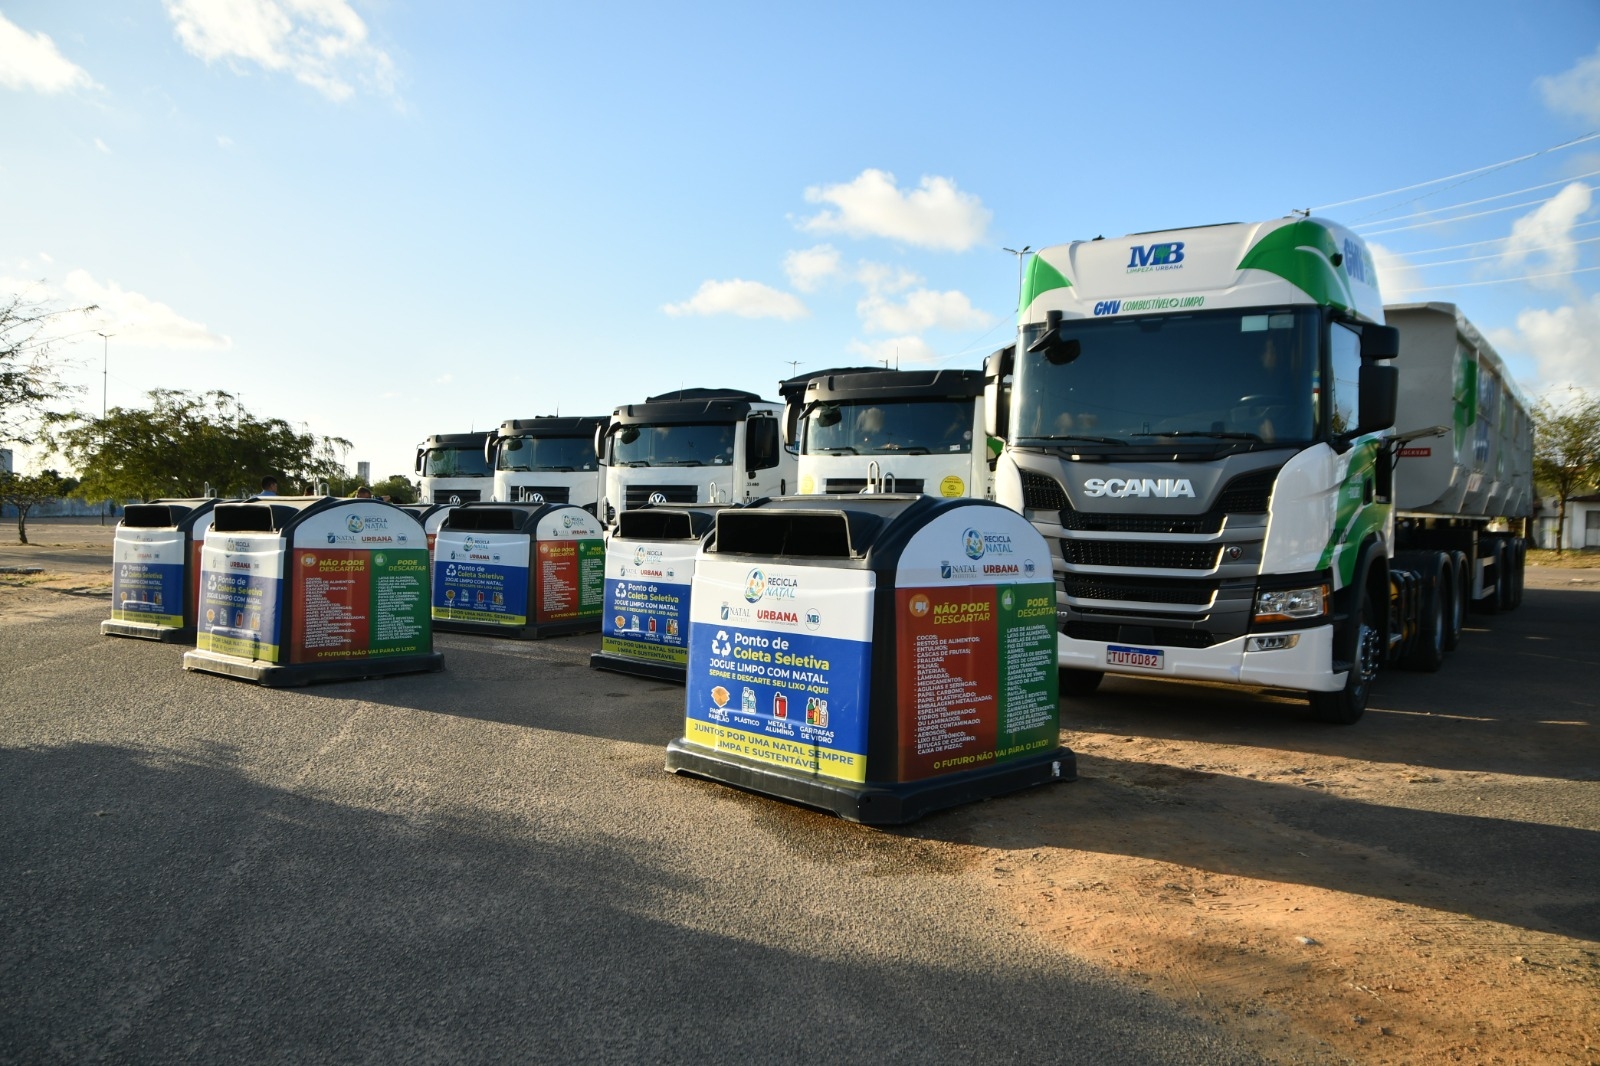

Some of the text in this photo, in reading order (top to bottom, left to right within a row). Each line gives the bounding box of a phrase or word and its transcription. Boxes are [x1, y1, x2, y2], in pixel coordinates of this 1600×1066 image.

[1094, 300, 1121, 315] GNV
[1180, 296, 1204, 307] LIMPO
[1084, 478, 1196, 498] SCANIA
[985, 544, 1013, 552] NATAL
[983, 565, 1018, 573] URBANA
[218, 576, 235, 585] Ponto
[768, 578, 798, 587] RECICLA
[217, 584, 236, 593] Coleta
[628, 583, 647, 591] Ponto
[765, 587, 795, 598] NATAL
[628, 592, 679, 603] Coleta Seletiva
[1027, 598, 1048, 607] PODE
[934, 602, 990, 614] NÃO PODE
[729, 607, 750, 617] NATAL
[757, 610, 798, 622] URBANA
[934, 612, 990, 624] DESCARTAR
[734, 632, 789, 650] Ponto de
[638, 650, 675, 660] SUSTENTÁVEL
[734, 647, 829, 670] Coleta Seletiva
[710, 658, 828, 684] JOGUE LIMPO COM NATAL.
[709, 669, 731, 679] SEPARE
[737, 673, 770, 686] DESCARTE
[772, 679, 786, 688] SEU
[788, 682, 805, 690] LIXO
[807, 684, 828, 694] AQUI!
[918, 684, 943, 692] AGULHAS
[940, 708, 976, 717] TEMPERADOS
[734, 715, 759, 726] PLÁSTICO
[768, 720, 787, 729] METAL
[765, 725, 794, 736] ALUMÍNIO
[800, 726, 834, 738] GARRAFAS
[694, 723, 854, 765] JUNTOS POR UMA NATAL SEMPRE
[812, 734, 832, 744] VIDRO
[745, 745, 750, 754] E
[752, 748, 822, 771] SUSTENTÁVEL
[942, 756, 975, 767] FUTURO
[977, 752, 993, 761] NÃO
[995, 749, 1006, 757] VAI
[1008, 746, 1024, 755] PARA
[1033, 740, 1048, 748] LIXO!
